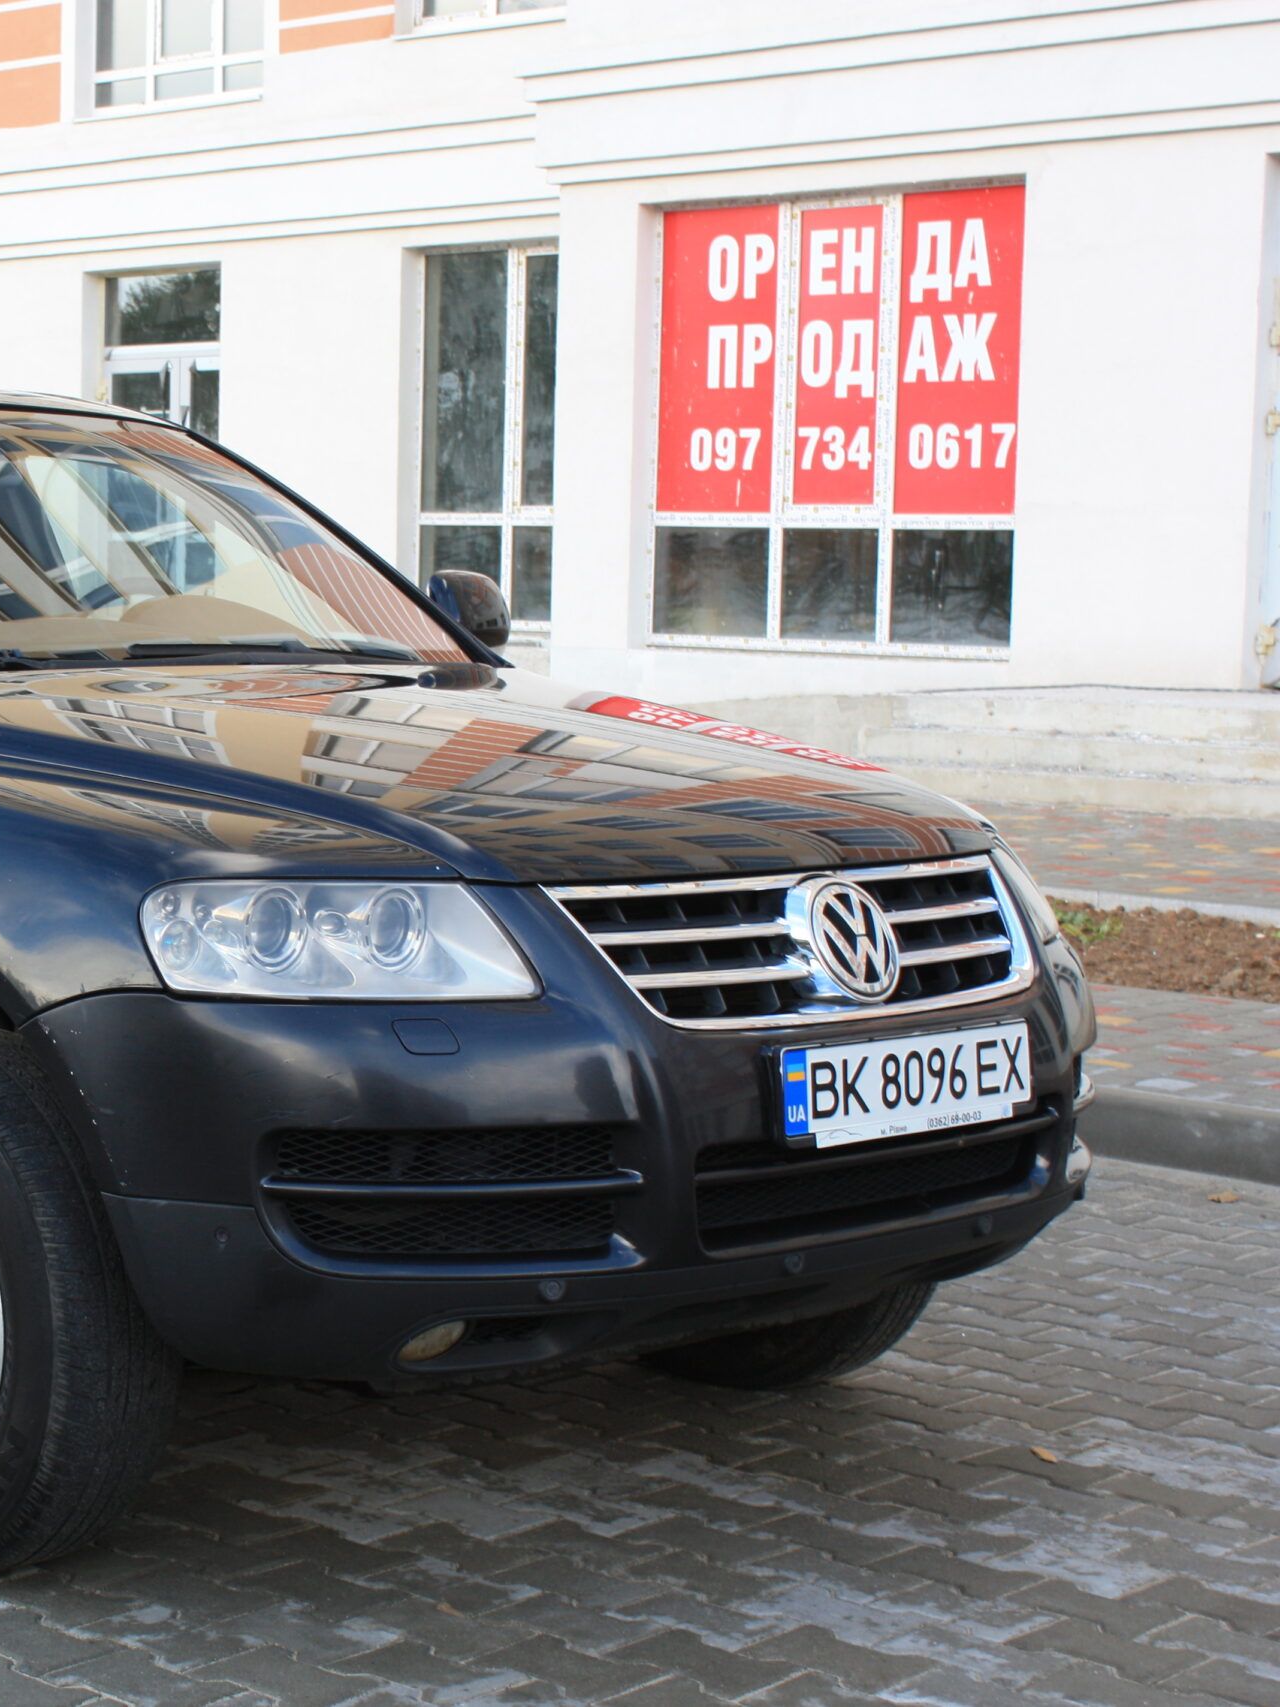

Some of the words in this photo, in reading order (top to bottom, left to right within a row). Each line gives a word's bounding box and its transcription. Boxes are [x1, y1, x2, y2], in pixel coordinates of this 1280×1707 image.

[690, 427, 761, 471] 097
[798, 426, 872, 471] 734
[908, 423, 1016, 469] 0617
[810, 1056, 870, 1120] BK
[881, 1044, 967, 1110] 8096
[976, 1036, 1025, 1097] EX
[787, 1104, 806, 1123] UA
